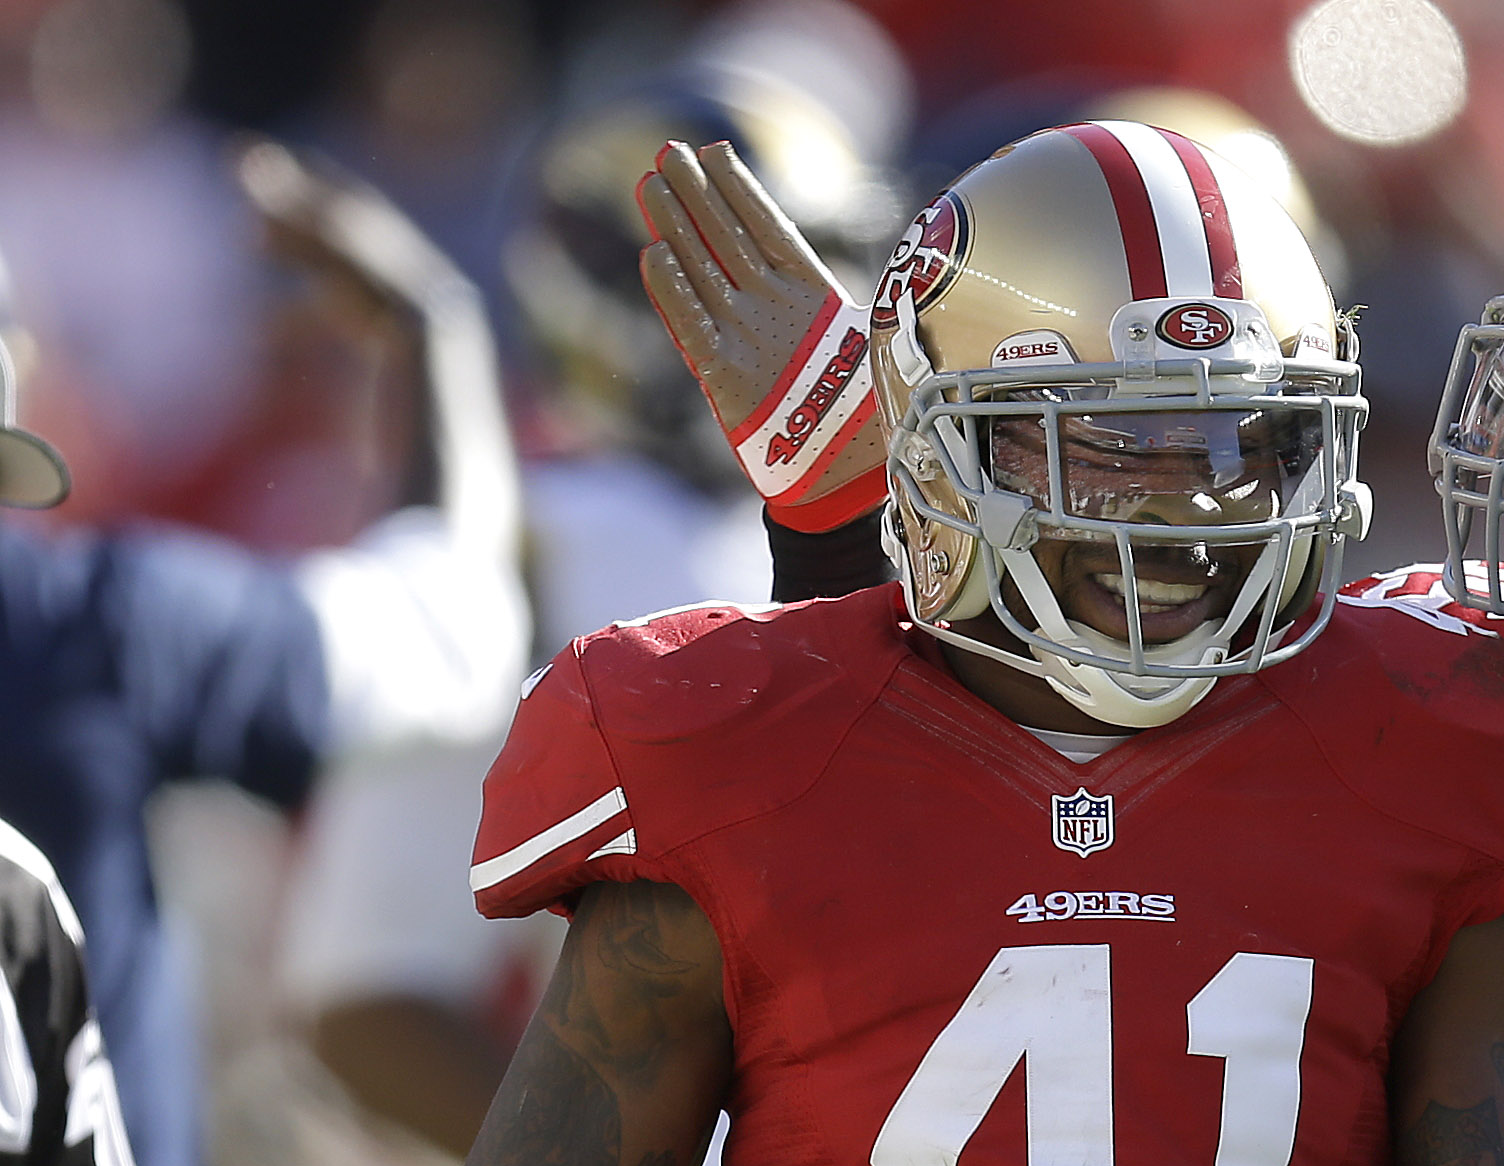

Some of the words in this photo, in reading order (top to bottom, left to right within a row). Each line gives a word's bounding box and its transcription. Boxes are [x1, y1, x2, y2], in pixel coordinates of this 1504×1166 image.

[1181, 311, 1222, 343] SF
[996, 341, 1058, 361] 49ERS
[1303, 335, 1330, 353] 49ERS
[765, 326, 870, 466] 49ERS
[1062, 819, 1105, 845] NFL
[1006, 891, 1176, 922] 49ERS
